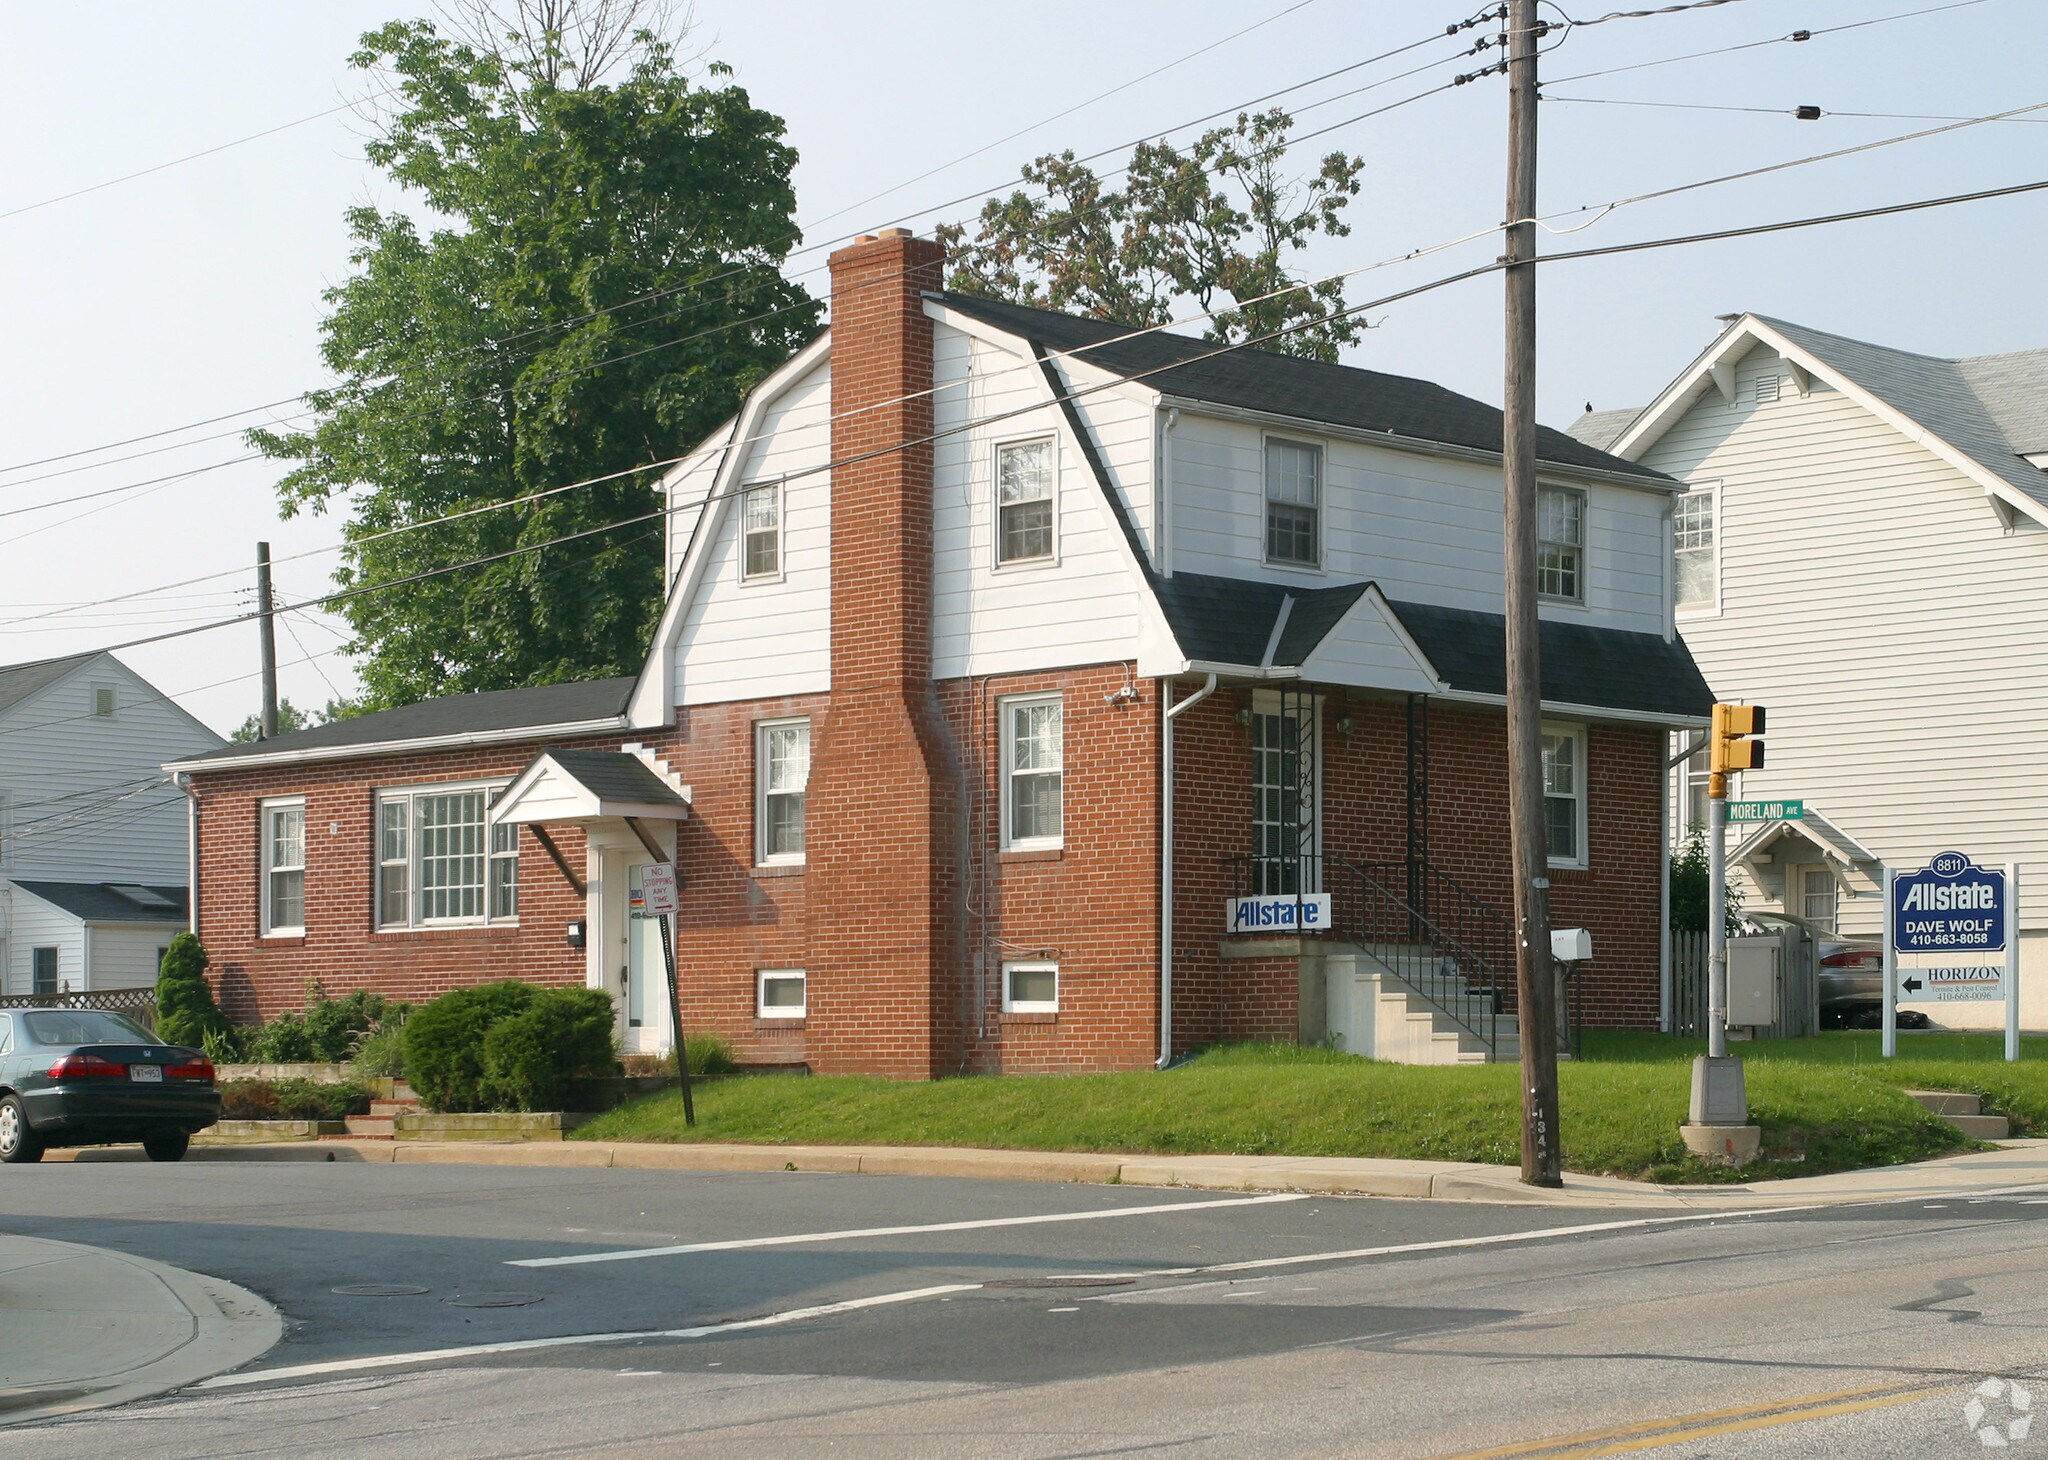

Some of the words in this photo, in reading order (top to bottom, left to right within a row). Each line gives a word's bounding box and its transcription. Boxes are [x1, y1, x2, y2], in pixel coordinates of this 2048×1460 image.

[1730, 803, 1783, 819] MORELAND
[1785, 806, 1798, 815] AVE
[1937, 859, 1961, 871] 8811
[651, 867, 663, 876] NO
[644, 877, 673, 887] STOPPING
[1905, 920, 1945, 933] DAVE
[1948, 919, 1993, 932] WOLF
[1910, 933, 1988, 945] 410-663-8058
[1928, 966, 2000, 980] HORIZON
[1974, 984, 1998, 992] Control
